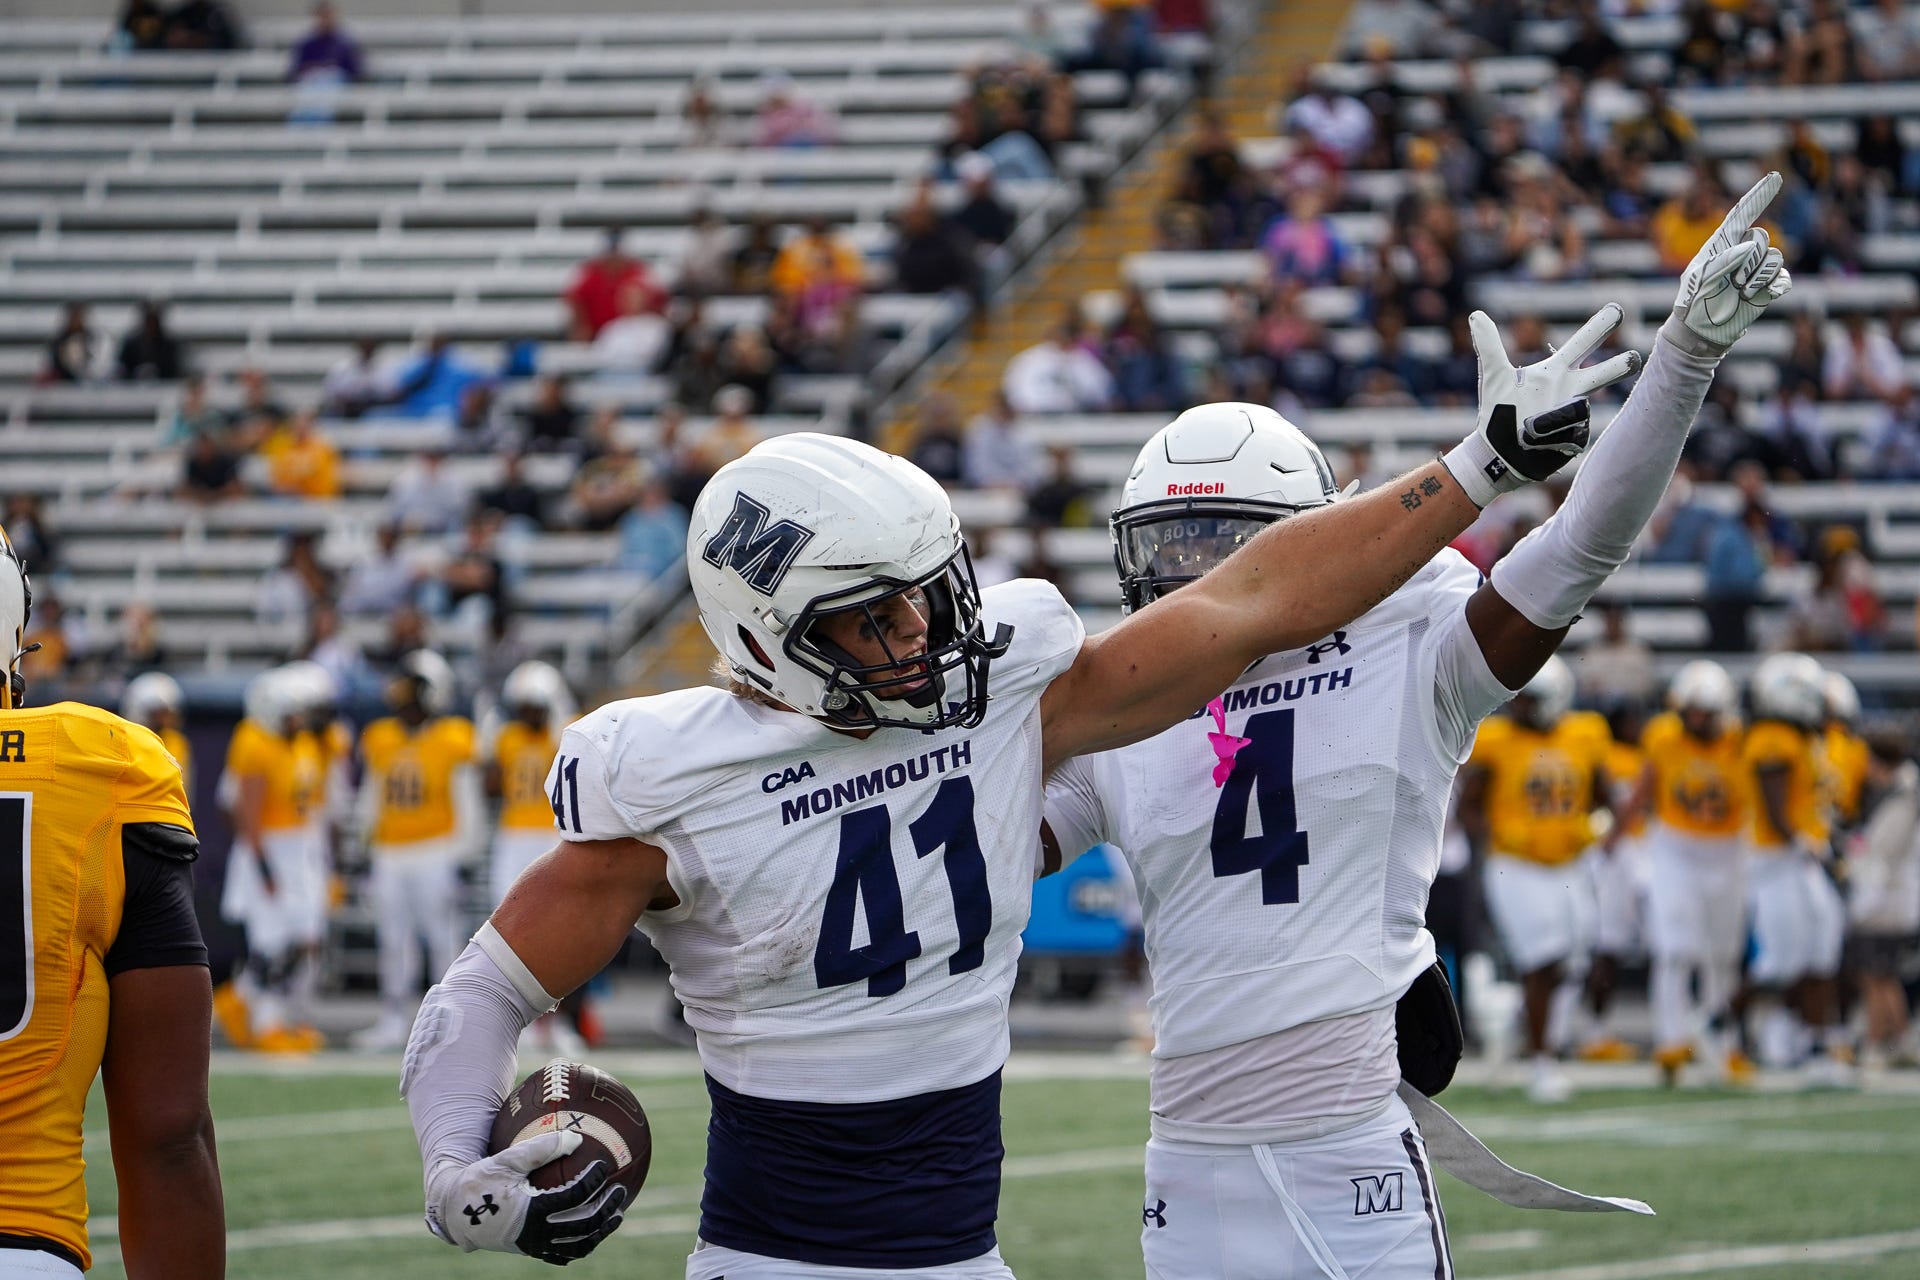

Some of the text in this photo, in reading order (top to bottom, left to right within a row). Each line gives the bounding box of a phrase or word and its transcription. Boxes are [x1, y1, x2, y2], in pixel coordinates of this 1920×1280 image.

[1166, 482, 1225, 496] Riddell
[702, 490, 816, 598] M
[1187, 667, 1354, 720] MOUTH
[551, 754, 583, 834] 41
[761, 760, 817, 794] CAA
[781, 739, 972, 827] MONMOUTH
[1210, 708, 1310, 905] 4
[813, 775, 993, 997] 41
[1350, 1172, 1403, 1216] M
